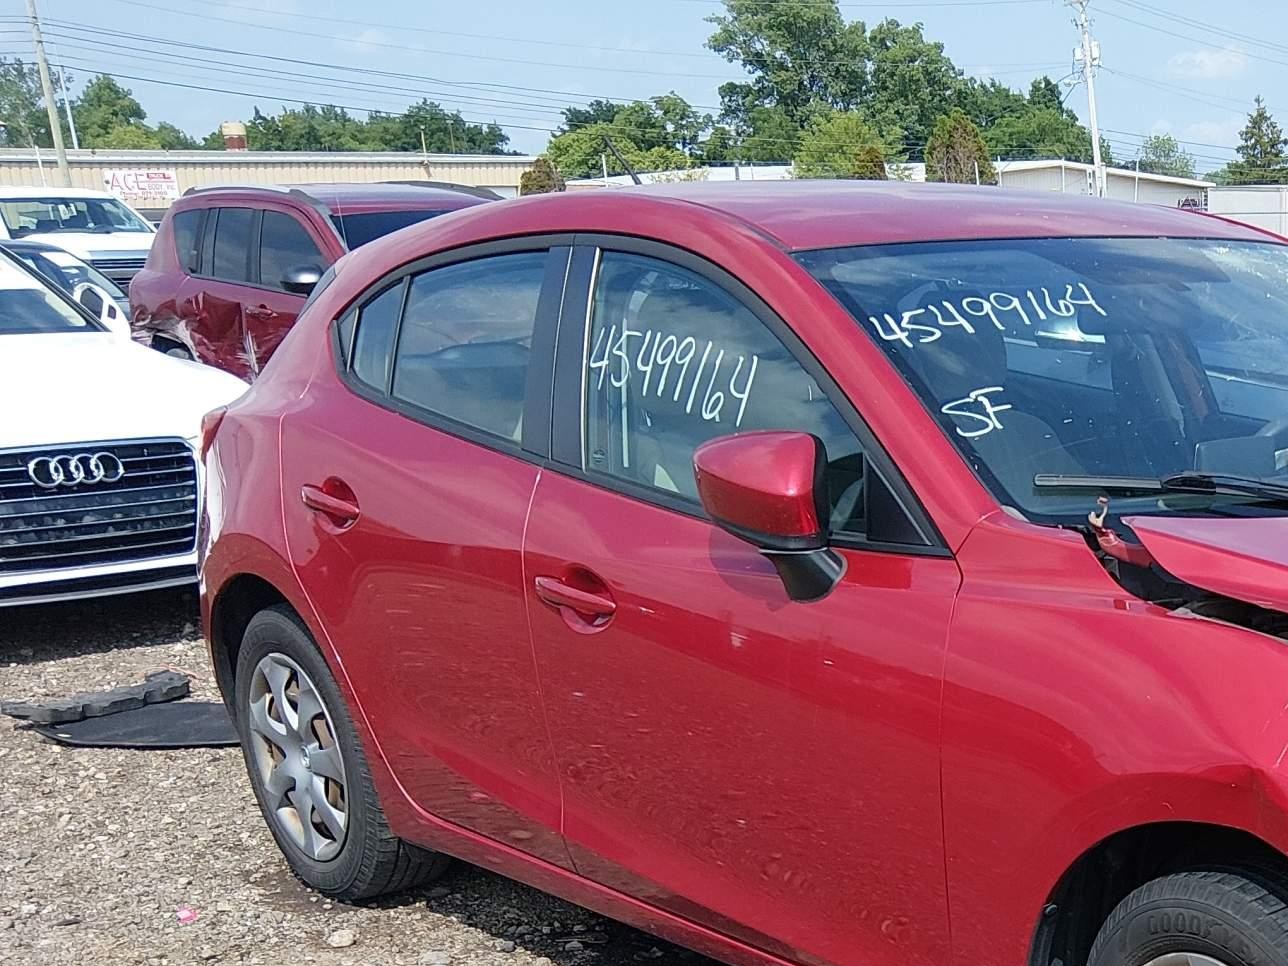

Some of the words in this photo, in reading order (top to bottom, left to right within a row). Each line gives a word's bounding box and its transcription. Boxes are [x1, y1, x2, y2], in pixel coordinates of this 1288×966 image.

[111, 172, 147, 191] ACE
[869, 283, 1107, 349] 45499164
[589, 325, 759, 427] 45499164
[940, 386, 1013, 438] SF
